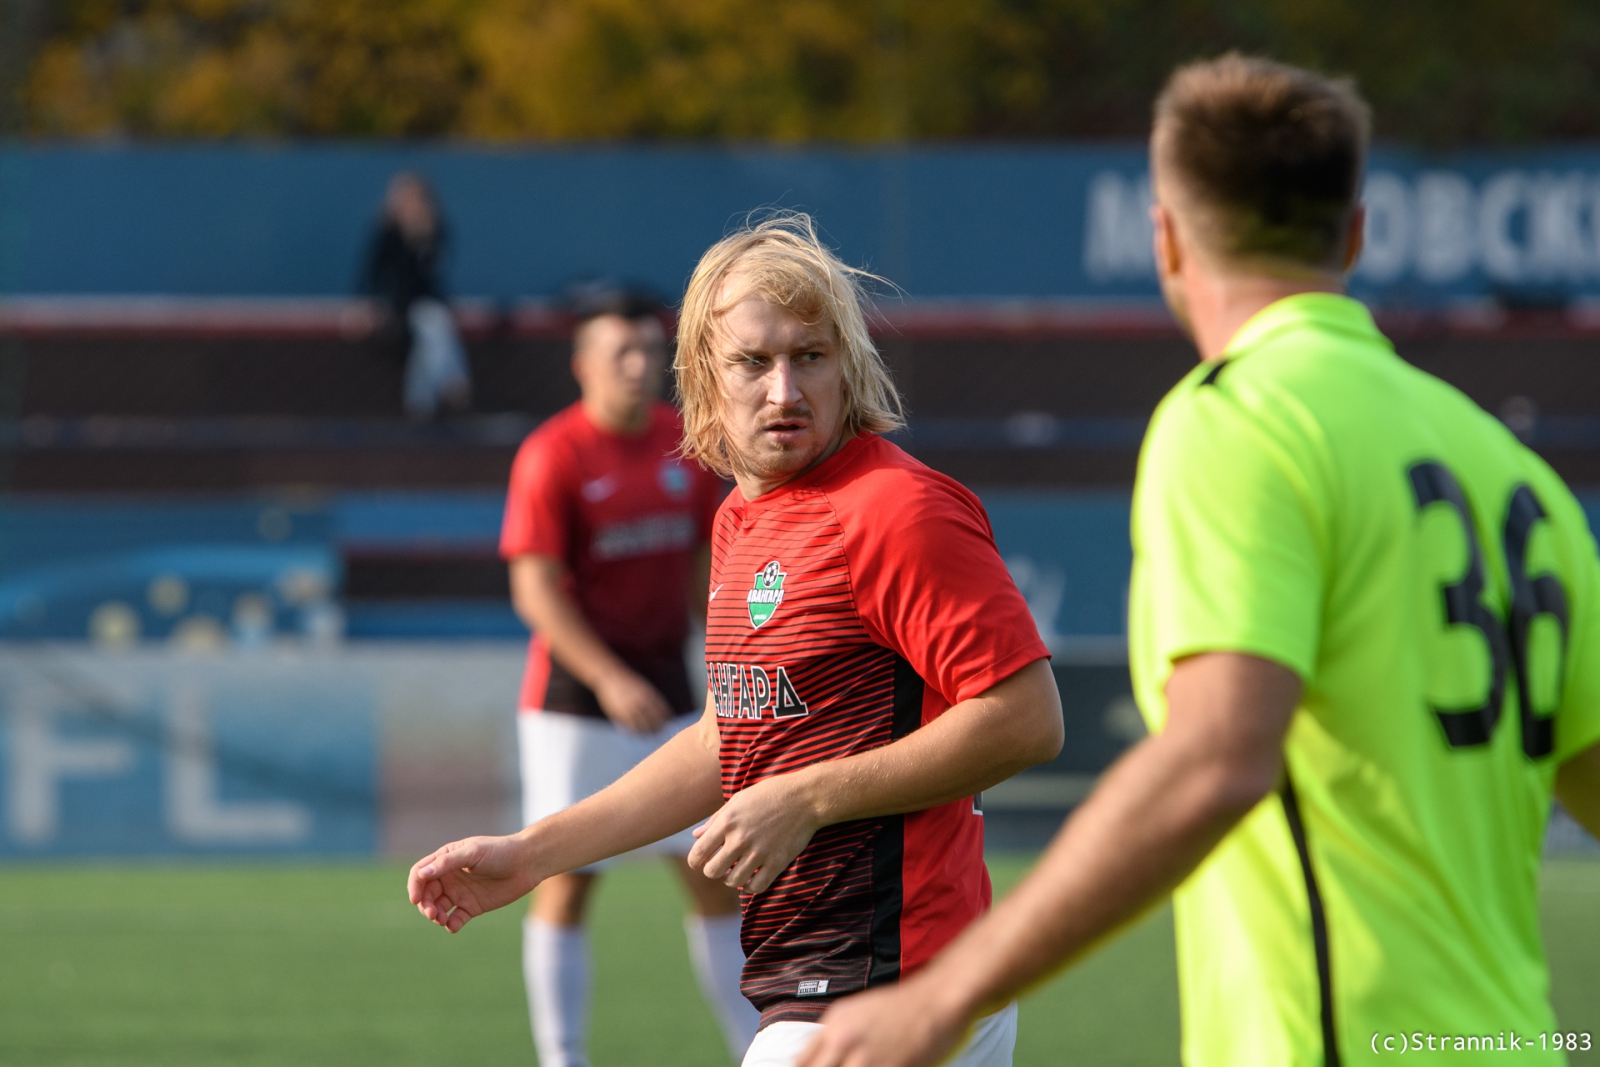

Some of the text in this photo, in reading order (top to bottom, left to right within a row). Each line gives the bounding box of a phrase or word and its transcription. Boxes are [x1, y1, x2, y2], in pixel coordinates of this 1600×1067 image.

[747, 589, 785, 604] АВАНГАРД
[1409, 461, 1569, 759] 36
[706, 662, 809, 720] АНГАРД
